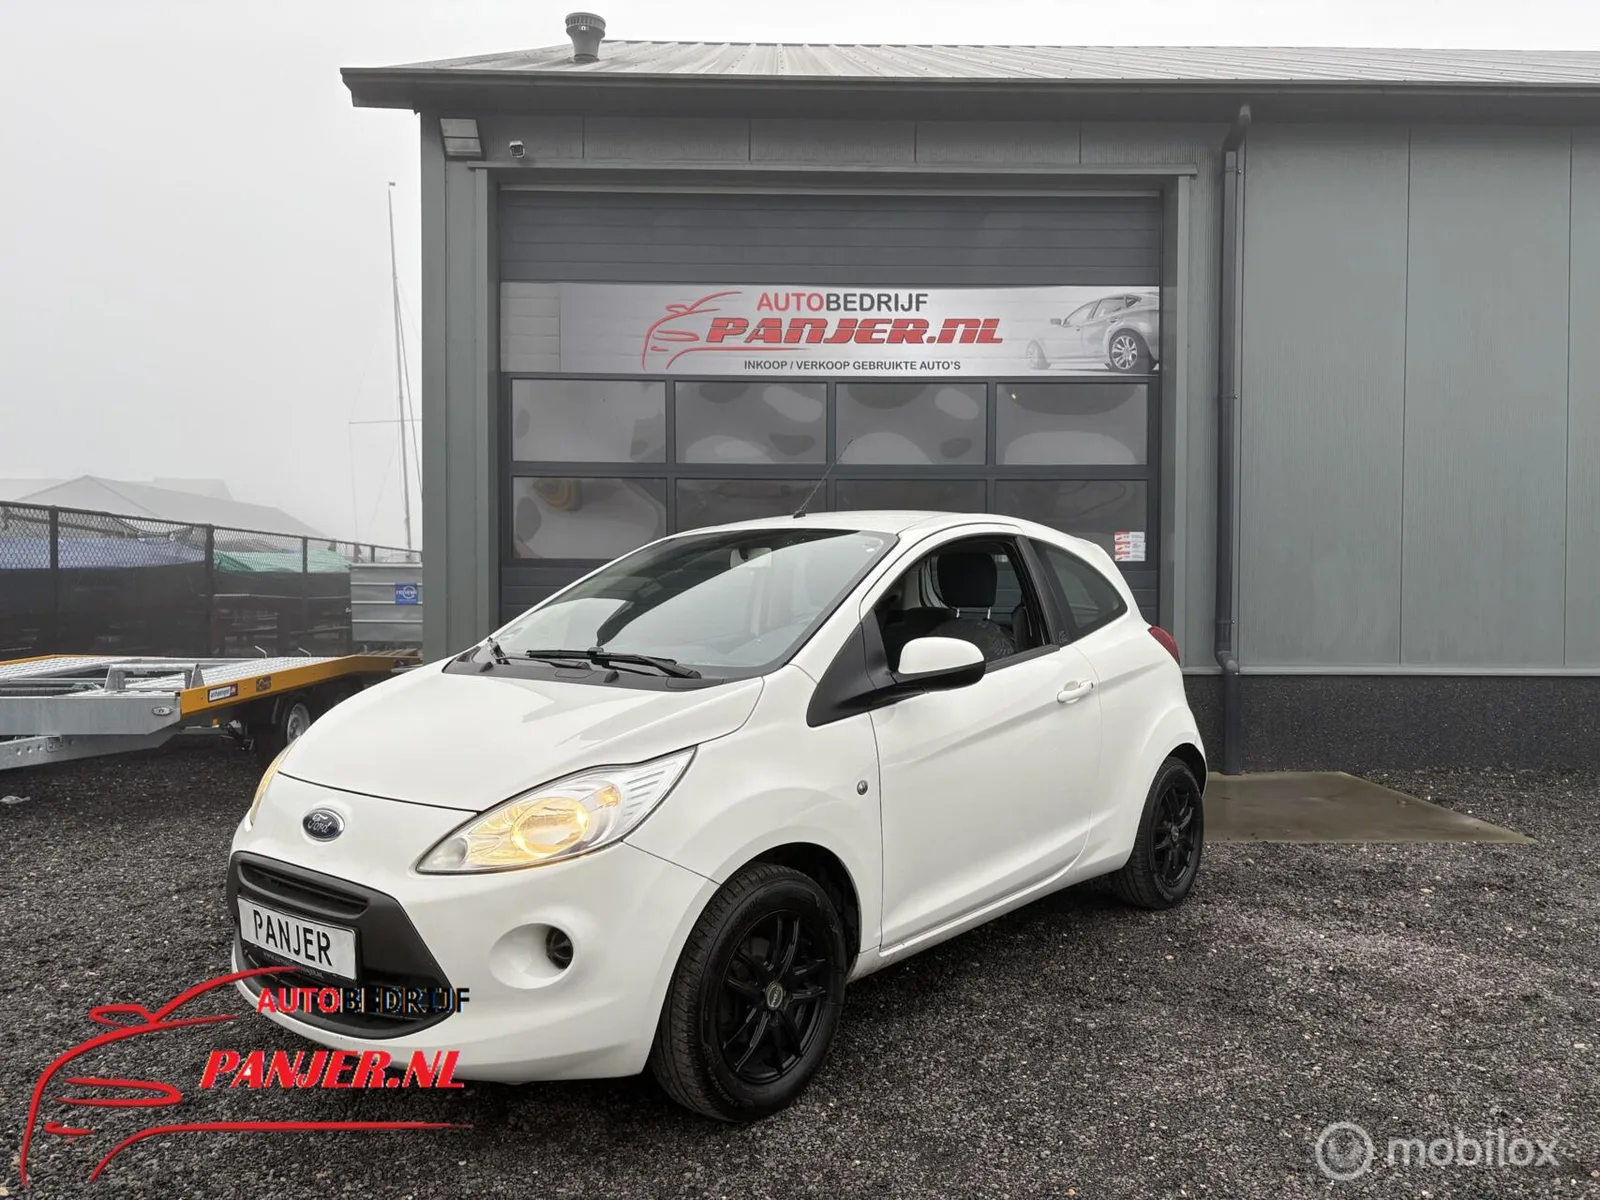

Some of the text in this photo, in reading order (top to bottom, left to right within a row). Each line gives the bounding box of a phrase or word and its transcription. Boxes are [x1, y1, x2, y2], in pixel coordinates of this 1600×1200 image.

[756, 292, 929, 312] AUTOBEDRIJF
[705, 317, 1004, 344] PANJER.NL
[744, 360, 788, 370] INKOOP
[796, 360, 850, 370] VERKOOP
[852, 360, 917, 371] GEBRUIKTE
[919, 360, 961, 371] AUTO'S
[307, 813, 333, 834] Ford
[252, 909, 333, 967] PANJER
